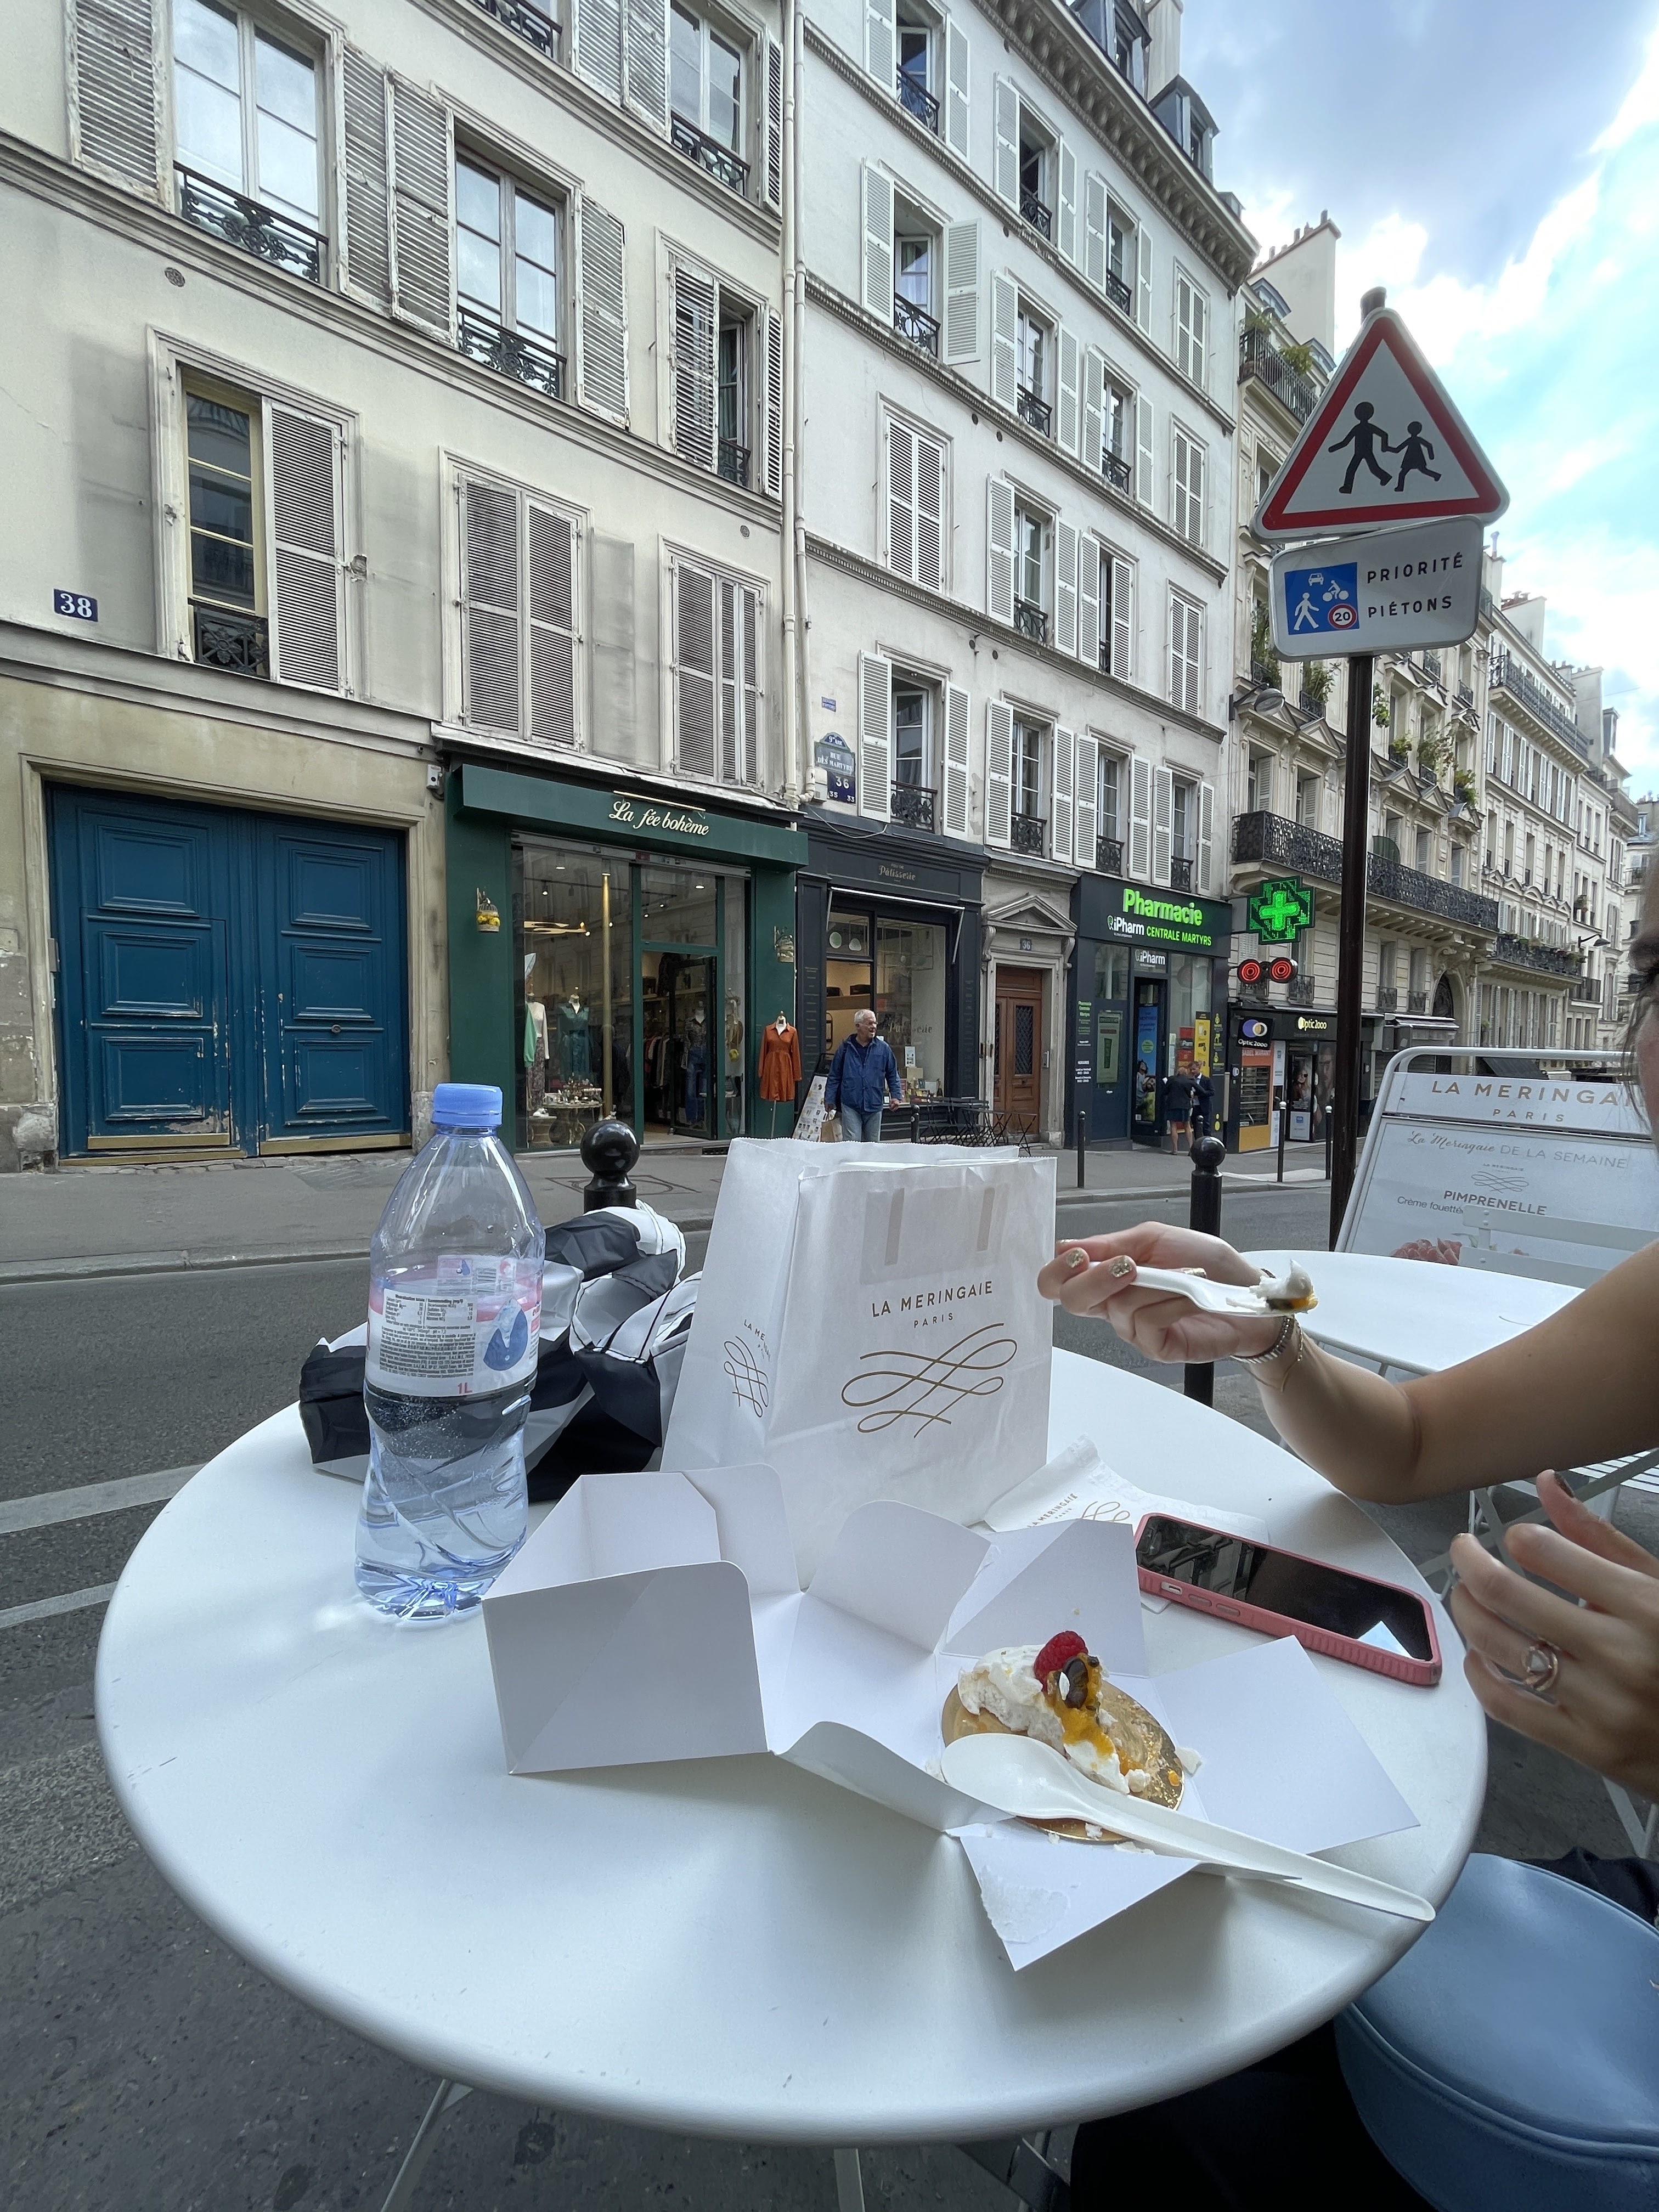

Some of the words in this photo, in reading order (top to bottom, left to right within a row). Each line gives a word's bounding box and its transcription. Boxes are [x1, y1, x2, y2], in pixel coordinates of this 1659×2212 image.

[1367, 552, 1463, 584] PRIORITÉ
[60, 593, 93, 618] 38
[1368, 596, 1452, 618] PIÉTONS
[1335, 611, 1351, 622] 20
[817, 755, 828, 765] DES
[829, 760, 853, 771] MARTYRS
[830, 752, 841, 760] RUE
[835, 775, 849, 789] 36
[609, 800, 635, 822] La
[633, 809, 662, 830] fée
[662, 810, 710, 836] bohème
[1122, 888, 1203, 926] Pharmacie
[1113, 916, 1145, 935] iPharm
[1146, 926, 1180, 941] CENTRALE
[1182, 932, 1212, 946] MARTYRS
[1022, 940, 1032, 951] 36
[1140, 949, 1166, 965] iPharm
[1431, 1080, 1461, 1096] LA
[1493, 1108, 1565, 1122] PARIS
[1407, 1131, 1426, 1144] La
[1430, 1132, 1495, 1154] Meringaie
[1500, 1144, 1521, 1156] DE
[1526, 1147, 1547, 1160] LA
[1553, 1152, 1628, 1169] SEMAINE
[1397, 1196, 1427, 1207] Crème
[1443, 1190, 1547, 1216] PIMPRENELLE
[872, 1300, 891, 1318] LA
[901, 1281, 994, 1312] MERINGAIE
[743, 1319, 752, 1331] LA
[913, 1312, 954, 1328] PARIS
[1037, 1493, 1078, 1521] MERINGAIE
